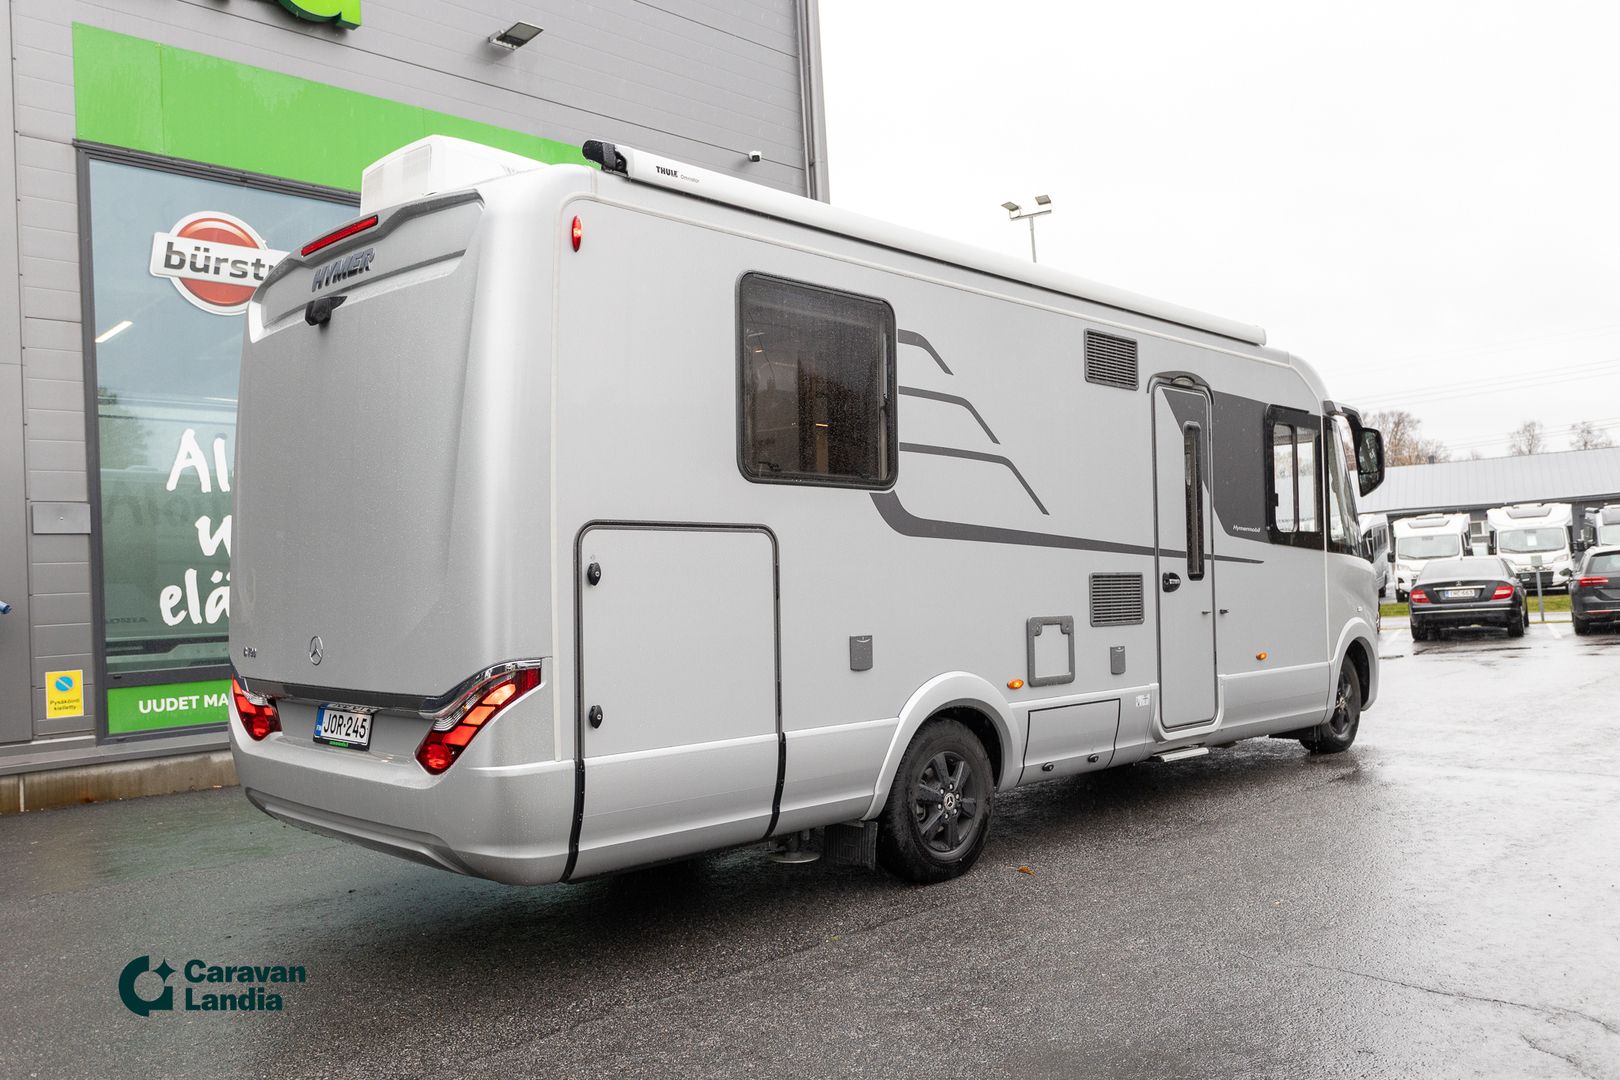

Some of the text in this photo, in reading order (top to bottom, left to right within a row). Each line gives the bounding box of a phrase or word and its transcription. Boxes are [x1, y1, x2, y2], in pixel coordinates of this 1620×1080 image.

[656, 165, 678, 178] THULE
[163, 241, 275, 281] bürst
[311, 247, 376, 293] HYMER
[138, 695, 200, 714] UUDET
[323, 713, 369, 739] JOR-245
